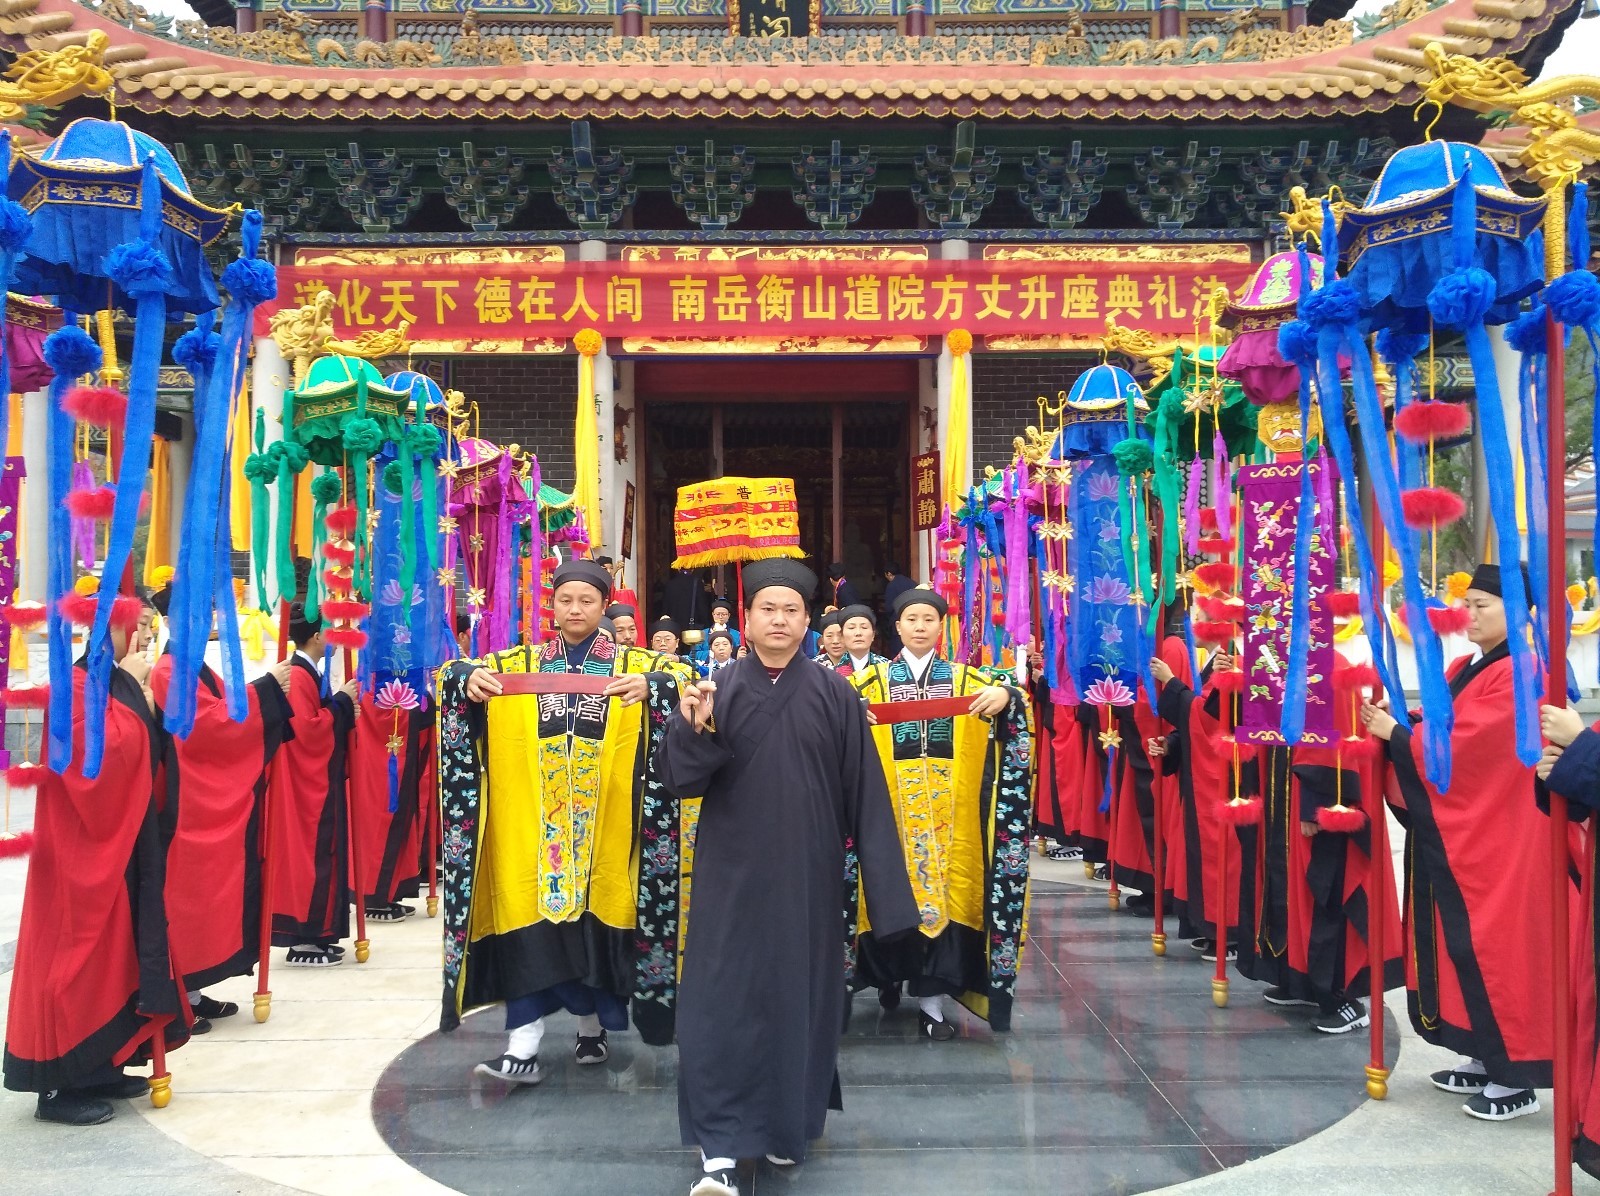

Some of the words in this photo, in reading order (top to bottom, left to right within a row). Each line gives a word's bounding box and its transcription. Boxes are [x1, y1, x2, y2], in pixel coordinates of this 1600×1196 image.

[474, 275, 642, 323] 德在人间
[669, 274, 1255, 322] 南岳衡山道院方丈升座典礼法
